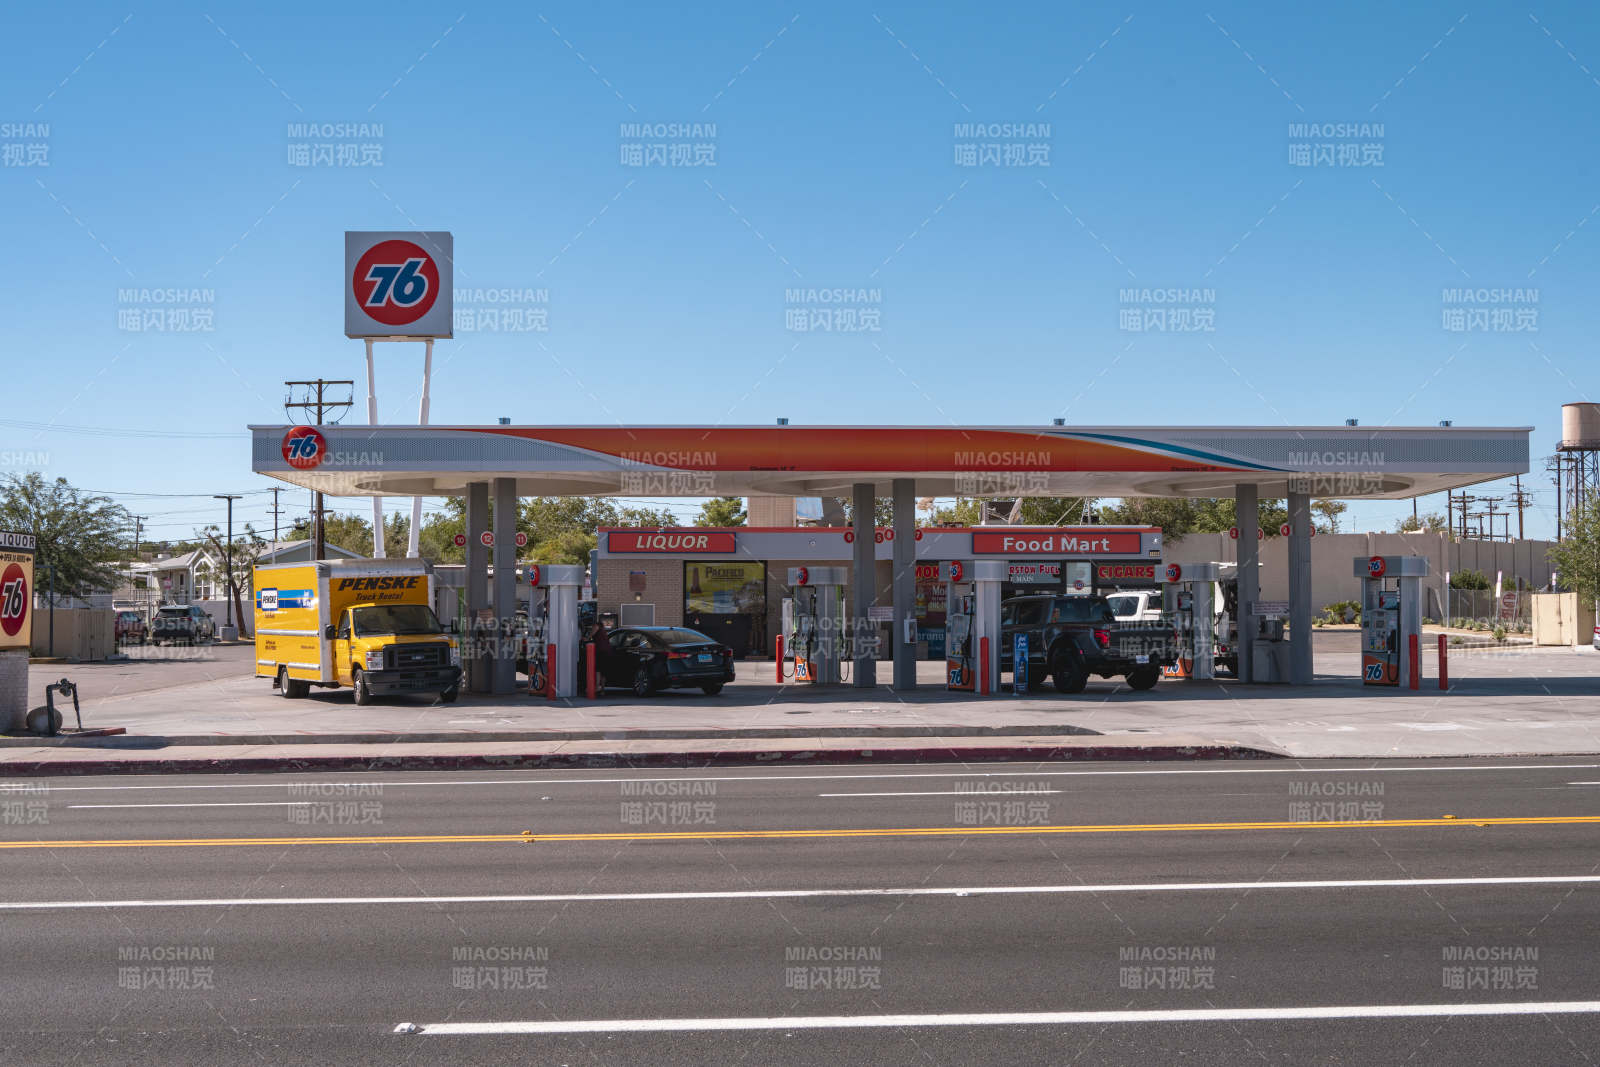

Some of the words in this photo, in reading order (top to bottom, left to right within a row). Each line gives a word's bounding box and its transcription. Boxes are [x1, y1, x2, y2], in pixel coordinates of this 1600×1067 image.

[364, 257, 428, 308] 76
[288, 434, 319, 460] 76
[635, 535, 709, 550] LIQUOR
[1003, 536, 1054, 551] Food
[1060, 537, 1110, 551] Mart
[1098, 566, 1155, 578] CIGARS
[1167, 567, 1176, 577] 76
[1370, 561, 1380, 571] 76
[338, 576, 420, 591] PENSKE
[2, 577, 24, 618] 76
[796, 663, 807, 677] 76
[950, 667, 962, 686] 76
[1366, 662, 1384, 681] 76
